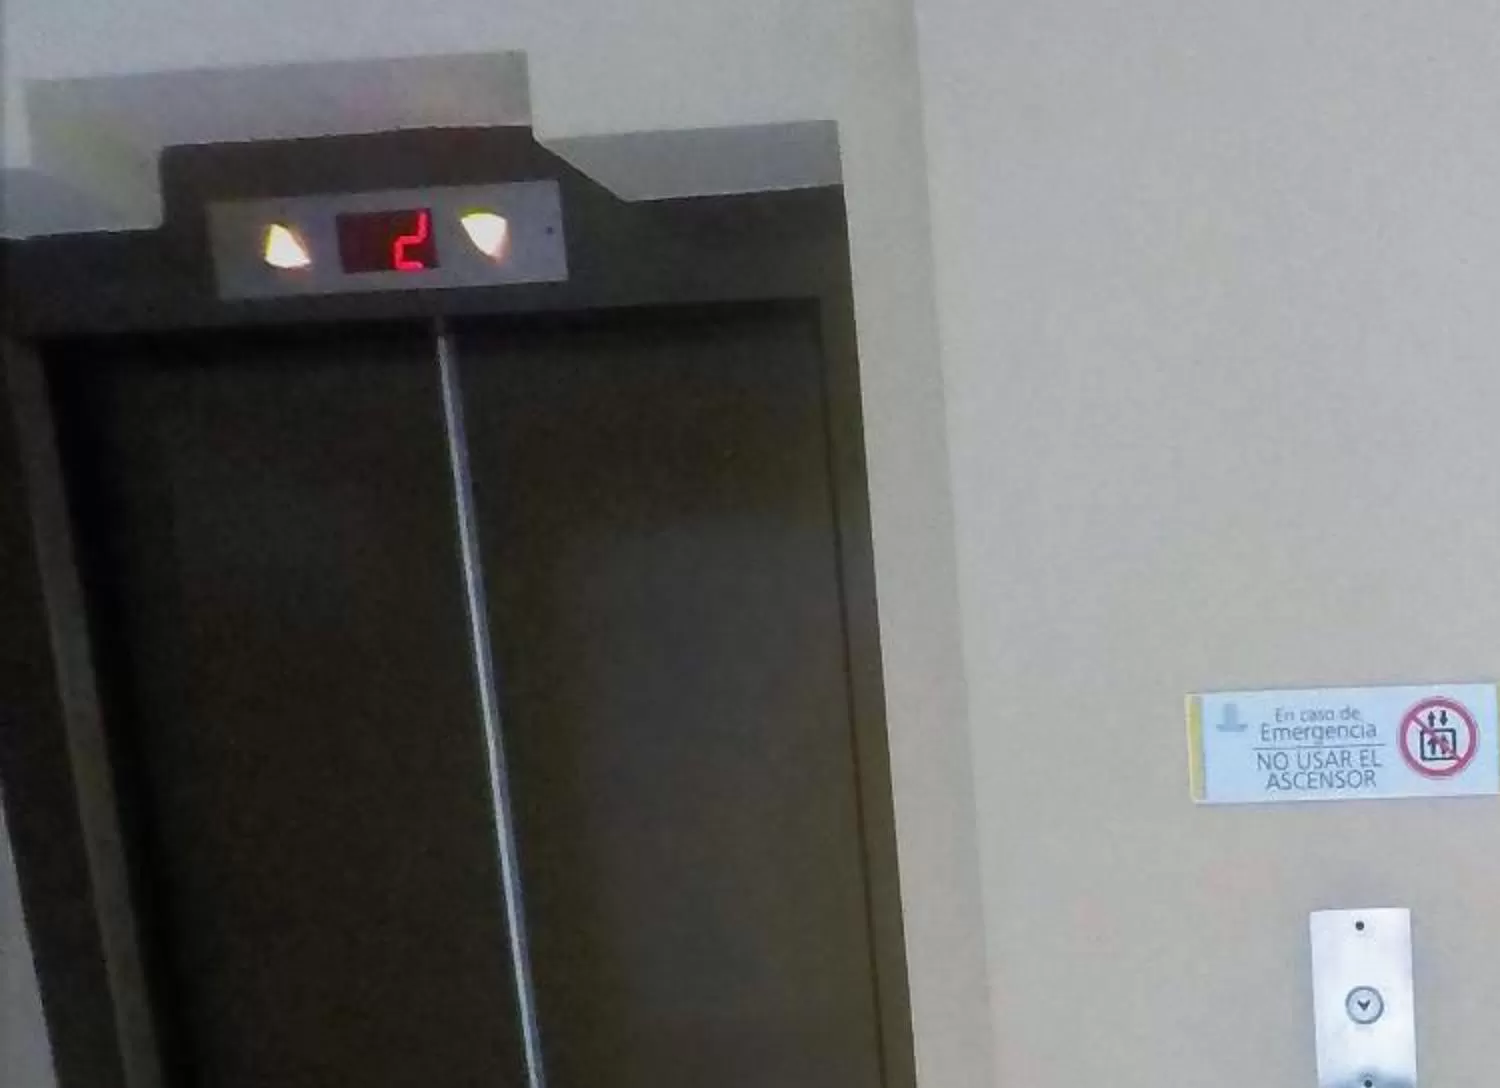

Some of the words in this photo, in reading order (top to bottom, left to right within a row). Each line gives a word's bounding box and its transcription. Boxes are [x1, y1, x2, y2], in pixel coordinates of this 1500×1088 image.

[392, 210, 428, 272] 2
[1275, 707, 1295, 722] En
[1300, 709, 1335, 721] caso
[1340, 706, 1361, 721] de
[1260, 721, 1378, 745] Emergencia
[1257, 752, 1289, 771] NO
[1297, 750, 1353, 769] USAR
[1360, 749, 1384, 768] EL
[1265, 770, 1377, 790] ASCENSOR
